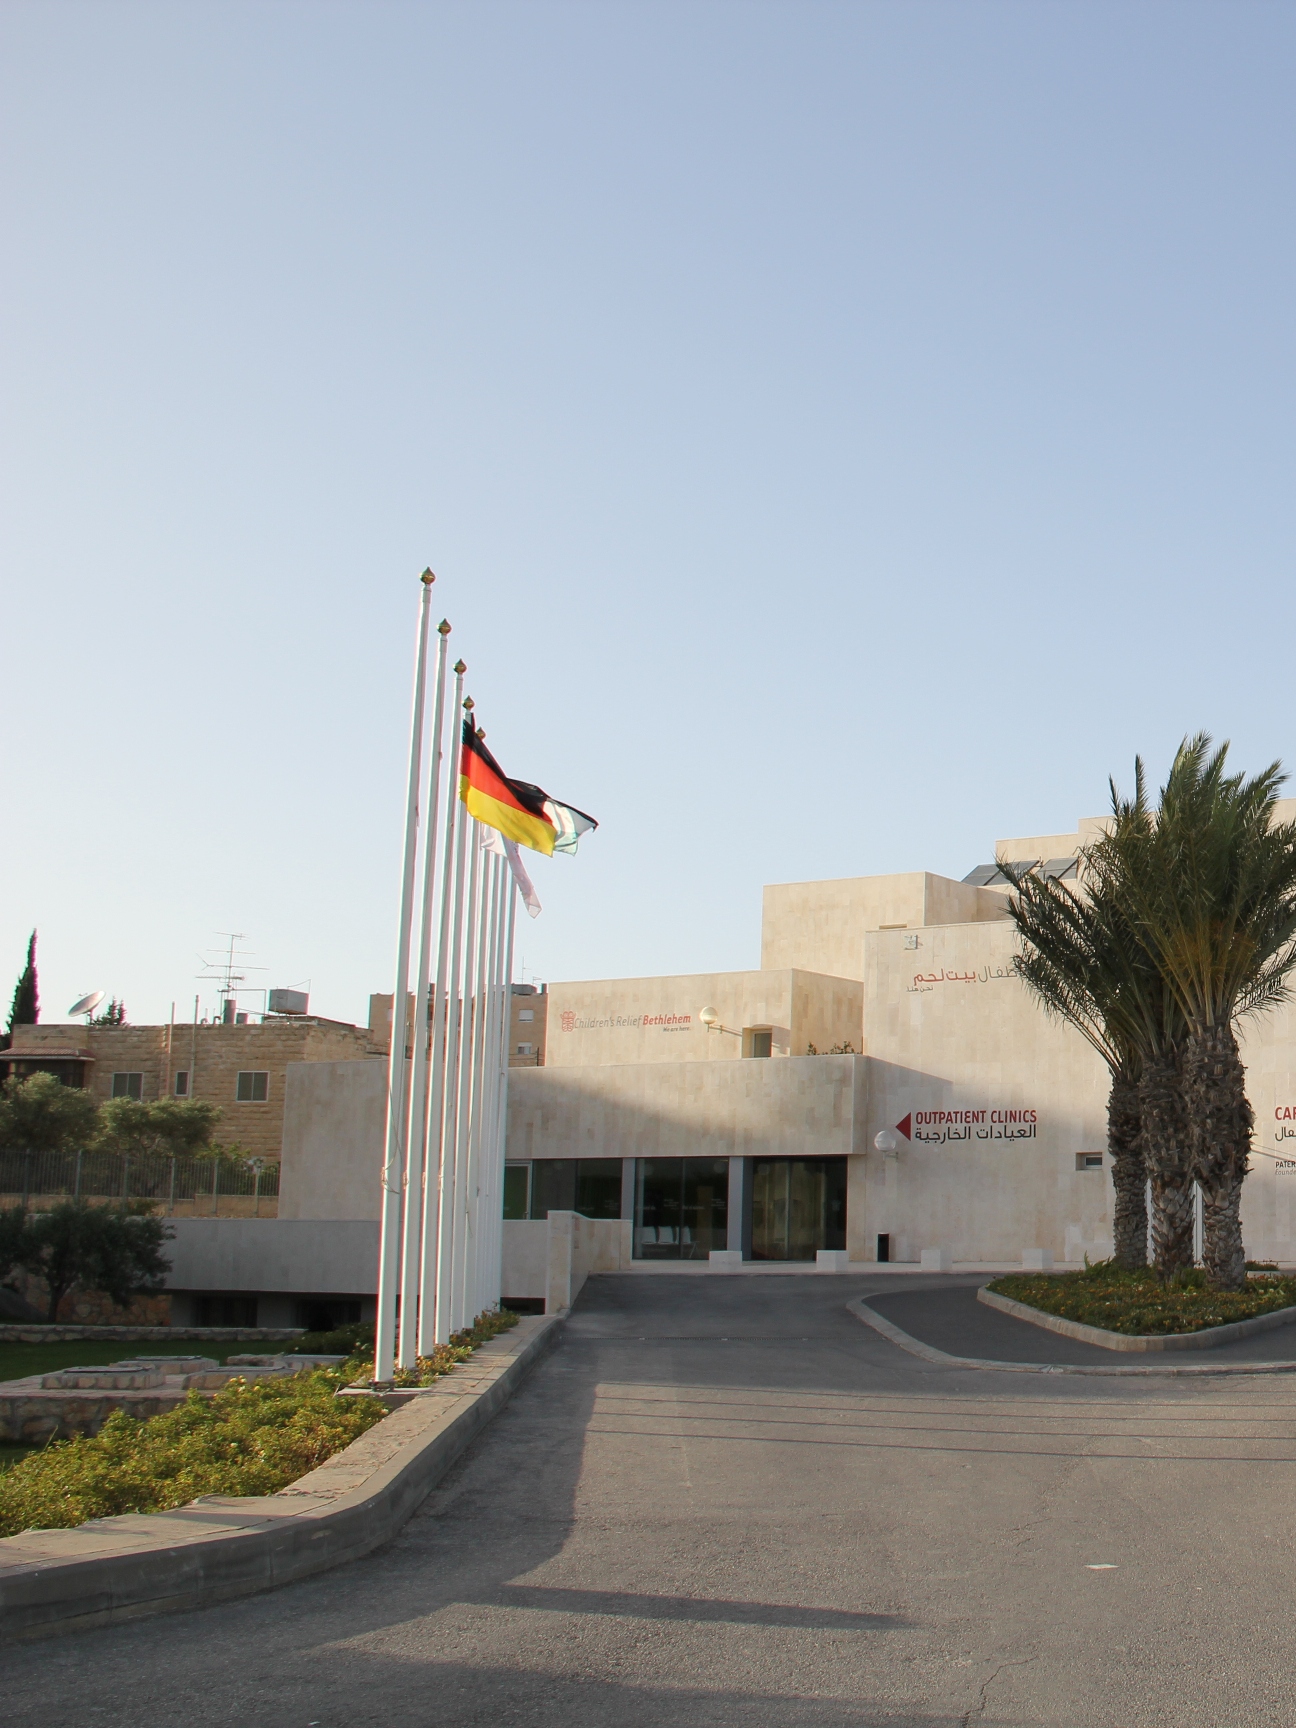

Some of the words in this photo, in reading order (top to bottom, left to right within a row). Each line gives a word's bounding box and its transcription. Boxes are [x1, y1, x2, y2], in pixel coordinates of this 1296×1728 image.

[913, 968, 945, 986] لحم
[945, 970, 977, 984] بيت
[977, 966, 1018, 983] طفال
[574, 1016, 615, 1029] Children's
[616, 1015, 642, 1028] Relief
[642, 1013, 691, 1026] Bethlehem
[915, 1110, 987, 1125] OUTPATIENT
[990, 1109, 1037, 1124] CLINICS
[914, 1126, 971, 1145] الخارجية
[976, 1123, 1037, 1142] العيادات
